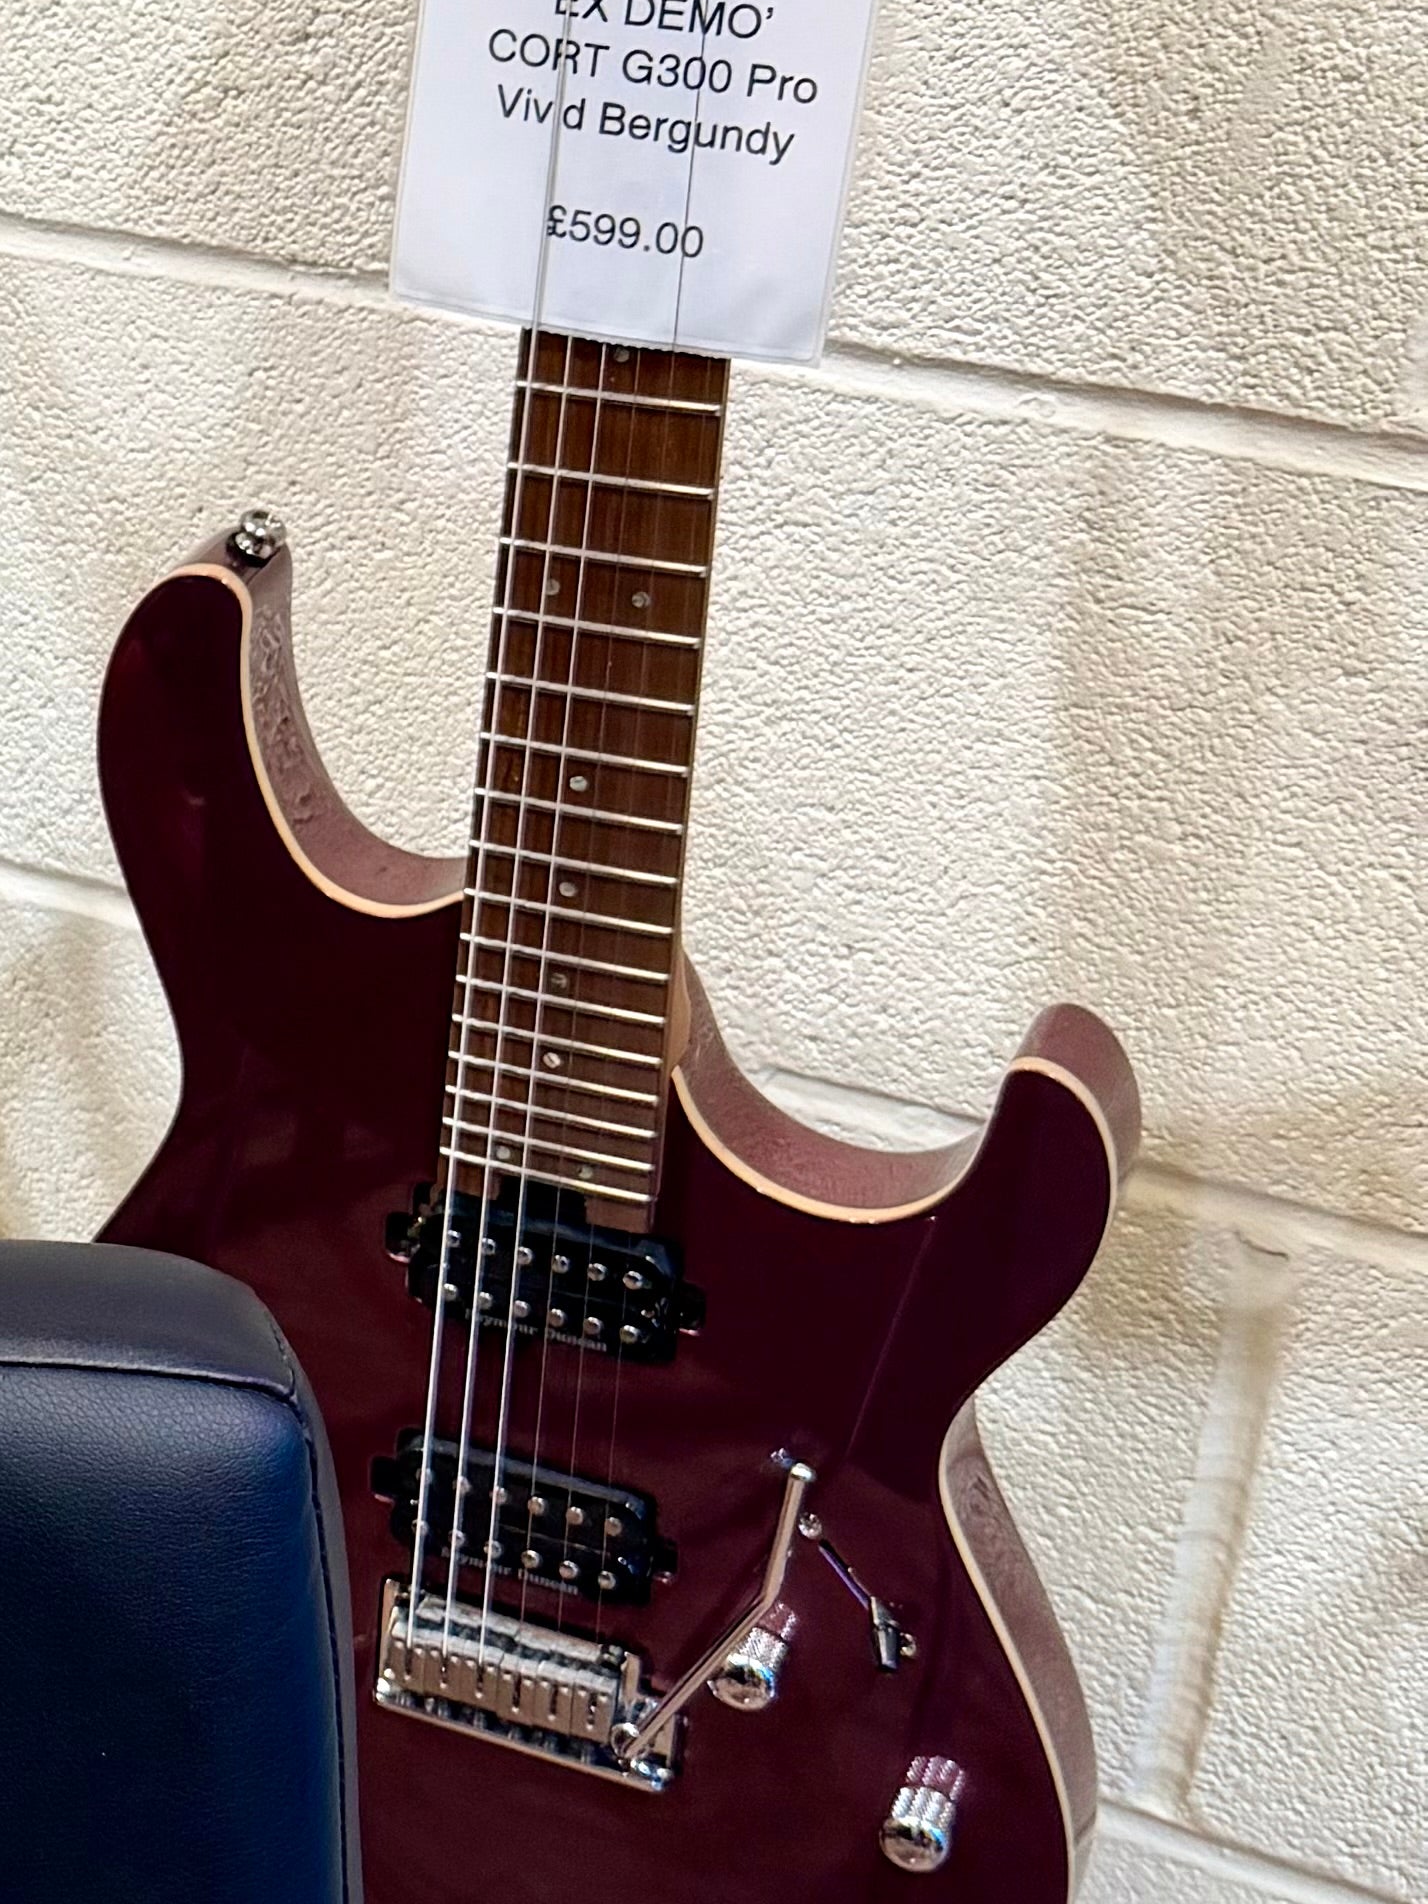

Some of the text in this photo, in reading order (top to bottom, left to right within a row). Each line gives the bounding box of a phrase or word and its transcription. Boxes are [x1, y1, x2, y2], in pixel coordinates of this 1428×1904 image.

[488, 29, 820, 104] CORT G300 Pro
[498, 84, 795, 166] Vivd Bergundy
[546, 204, 705, 259] £599.00
[464, 1307, 608, 1352] ymour Duncan
[439, 1545, 580, 1596] Symur Duncan
